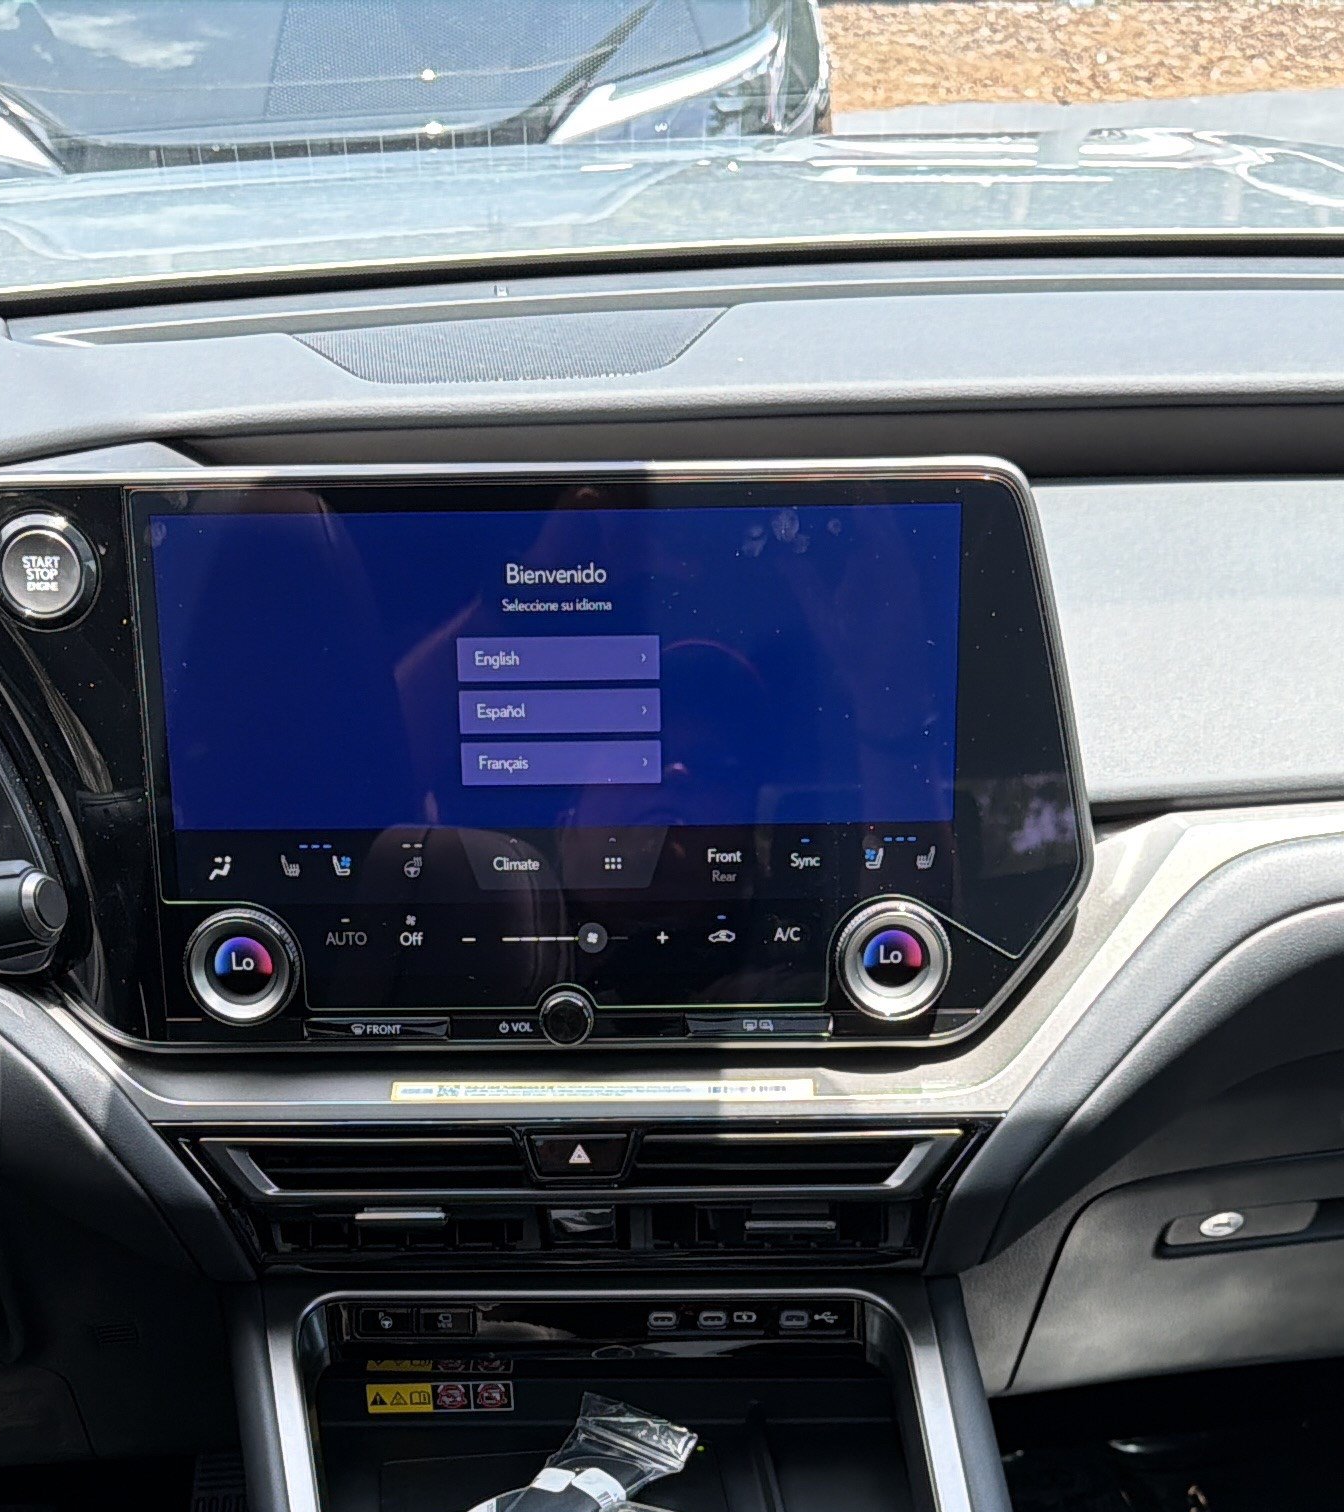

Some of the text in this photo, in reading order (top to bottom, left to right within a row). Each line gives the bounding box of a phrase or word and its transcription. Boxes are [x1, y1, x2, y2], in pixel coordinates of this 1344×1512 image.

[21, 555, 61, 568] START
[25, 568, 59, 581] STOP
[505, 562, 607, 585] Bienvenido
[502, 598, 612, 612] Seleccione su idioma
[474, 650, 520, 669] English
[476, 703, 526, 722] Español
[478, 755, 529, 773] Français
[492, 856, 540, 872] Climate
[706, 848, 742, 865] Front
[790, 854, 821, 869] Sync
[712, 870, 738, 883] Rear
[325, 931, 368, 947] AUTO
[399, 931, 424, 947] Off
[773, 927, 801, 943] A/C
[231, 951, 255, 972] Lo
[879, 945, 902, 965] Lo
[366, 1023, 402, 1036] FRONT
[511, 1022, 533, 1034] VOL
